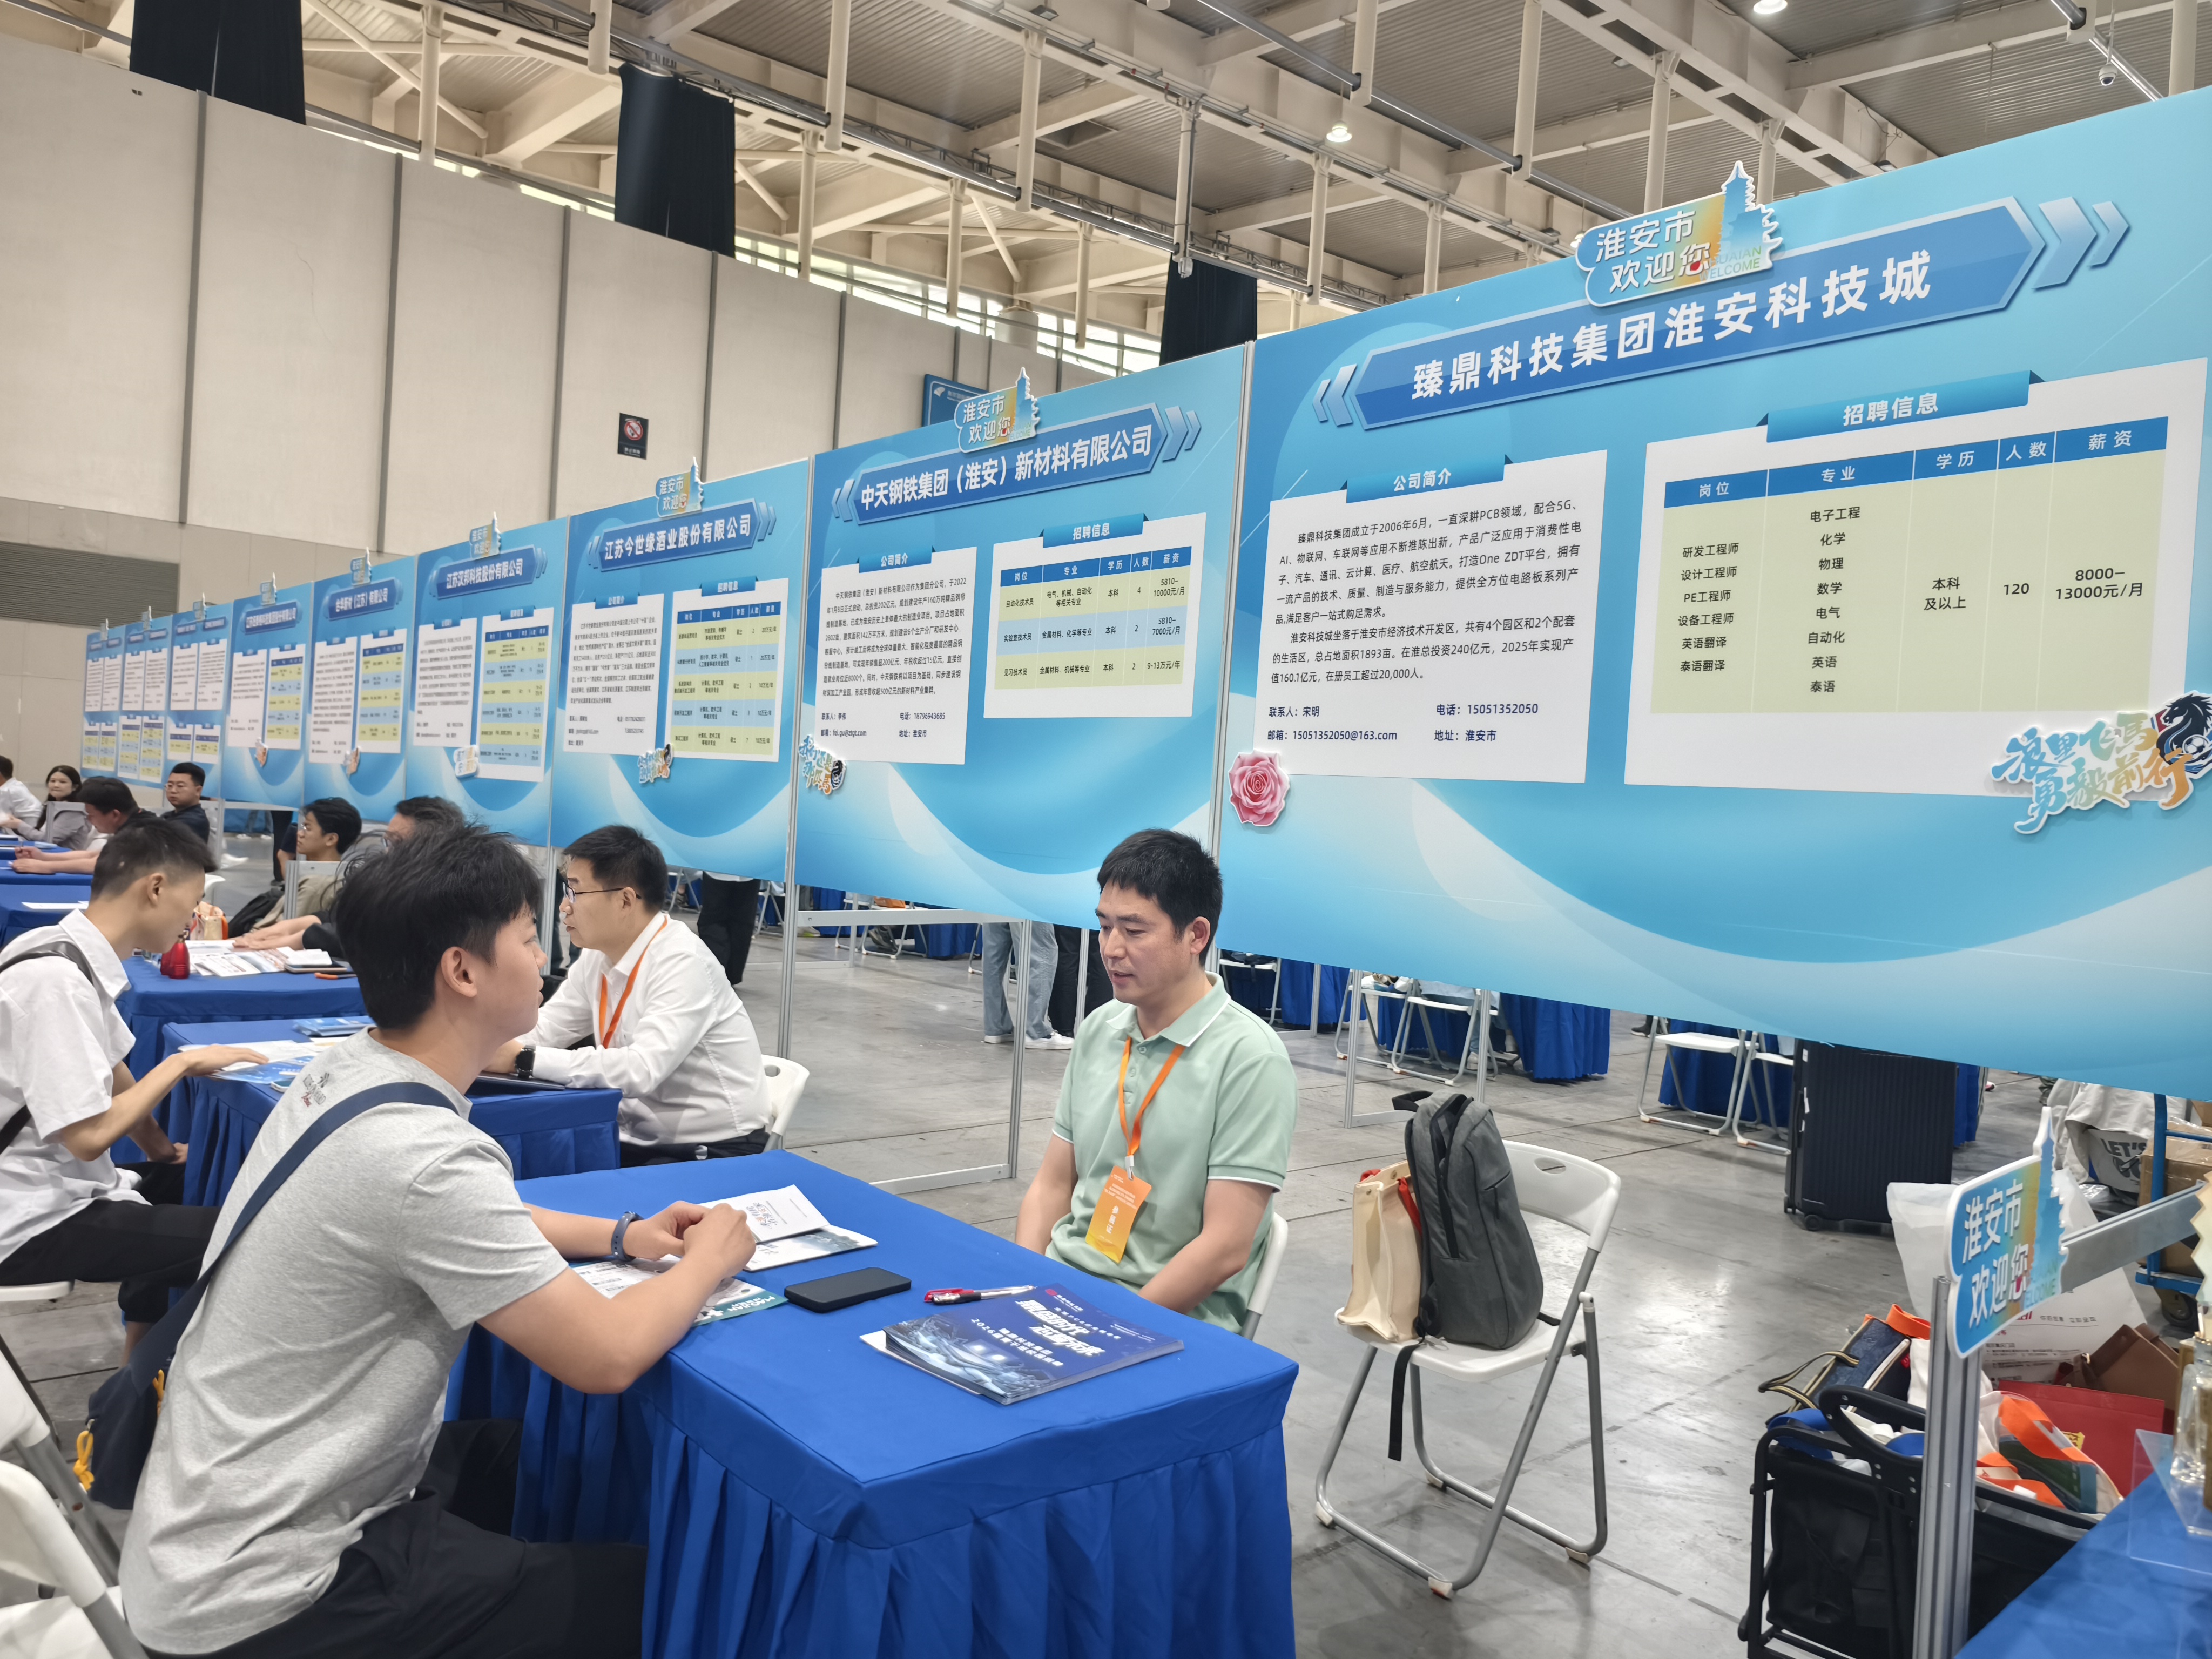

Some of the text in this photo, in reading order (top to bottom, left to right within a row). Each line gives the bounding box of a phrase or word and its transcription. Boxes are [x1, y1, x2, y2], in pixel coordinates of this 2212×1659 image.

[1595, 210, 1696, 262] 淮安市
[1609, 242, 1711, 293] 欢迎您
[1700, 257, 1761, 282] WELCOME
[1411, 249, 1932, 401] 臻鼎科技集团淮安科技城
[963, 395, 1004, 423] 淮安市
[1843, 392, 1939, 427] 招聘信息
[968, 416, 1011, 444] 欢迎您
[2088, 430, 2132, 451] 薪资
[2005, 441, 2047, 462] 人数
[861, 424, 1152, 510] 中天钢铁集团（淮安）新材料有限公司
[1936, 451, 1974, 469] 学历
[1393, 468, 1452, 492] 公司简介
[1821, 466, 1856, 483] 专业
[659, 476, 684, 495] 淮安市
[1699, 481, 1729, 498] 岗位
[663, 493, 687, 510] 欢迎您
[1810, 507, 1860, 522] 电子工程
[604, 514, 751, 561] 江苏今世缘酒业股份有限公司
[1073, 522, 1110, 541] 招聘信息
[1820, 532, 1845, 546] 化学
[1682, 543, 1739, 558] 研发工程师
[881, 552, 908, 567] 公司简介
[1108, 559, 1123, 571] 学历
[1133, 556, 1149, 568] 人数
[1819, 557, 1844, 570] 物理
[1064, 565, 1078, 576] 专业
[1681, 566, 1737, 581] 设计工程师
[1153, 586, 1185, 597] 10000元/月
[1817, 582, 1842, 595] 数学
[1932, 577, 1960, 591] 本科
[2004, 583, 2030, 595] 120
[1108, 588, 1119, 597] 本科
[1684, 590, 1731, 603] PE工程师
[2055, 583, 2143, 601] 13000元/月
[1924, 596, 1966, 611] 及以上
[1678, 613, 1734, 627] 设备工程师
[1816, 607, 1841, 619] 电气
[1105, 626, 1116, 635] 本科
[1152, 626, 1181, 636] 7000元/月
[1808, 631, 1845, 644] 自动化
[1682, 637, 1727, 649] 英语翻译
[1103, 663, 1114, 672] 本科
[1680, 660, 1725, 672] 泰语翻译
[1812, 656, 1837, 669] 英语
[1810, 681, 1836, 693] 泰语
[1269, 703, 1539, 717] 联系人：宋明 电话：15051352050
[1267, 729, 1497, 742] 邮箱：15051352050@163.com 地址：淮安市
[1962, 1178, 2023, 1264] 淮安市
[1969, 1243, 2028, 1328] 欢迎您
